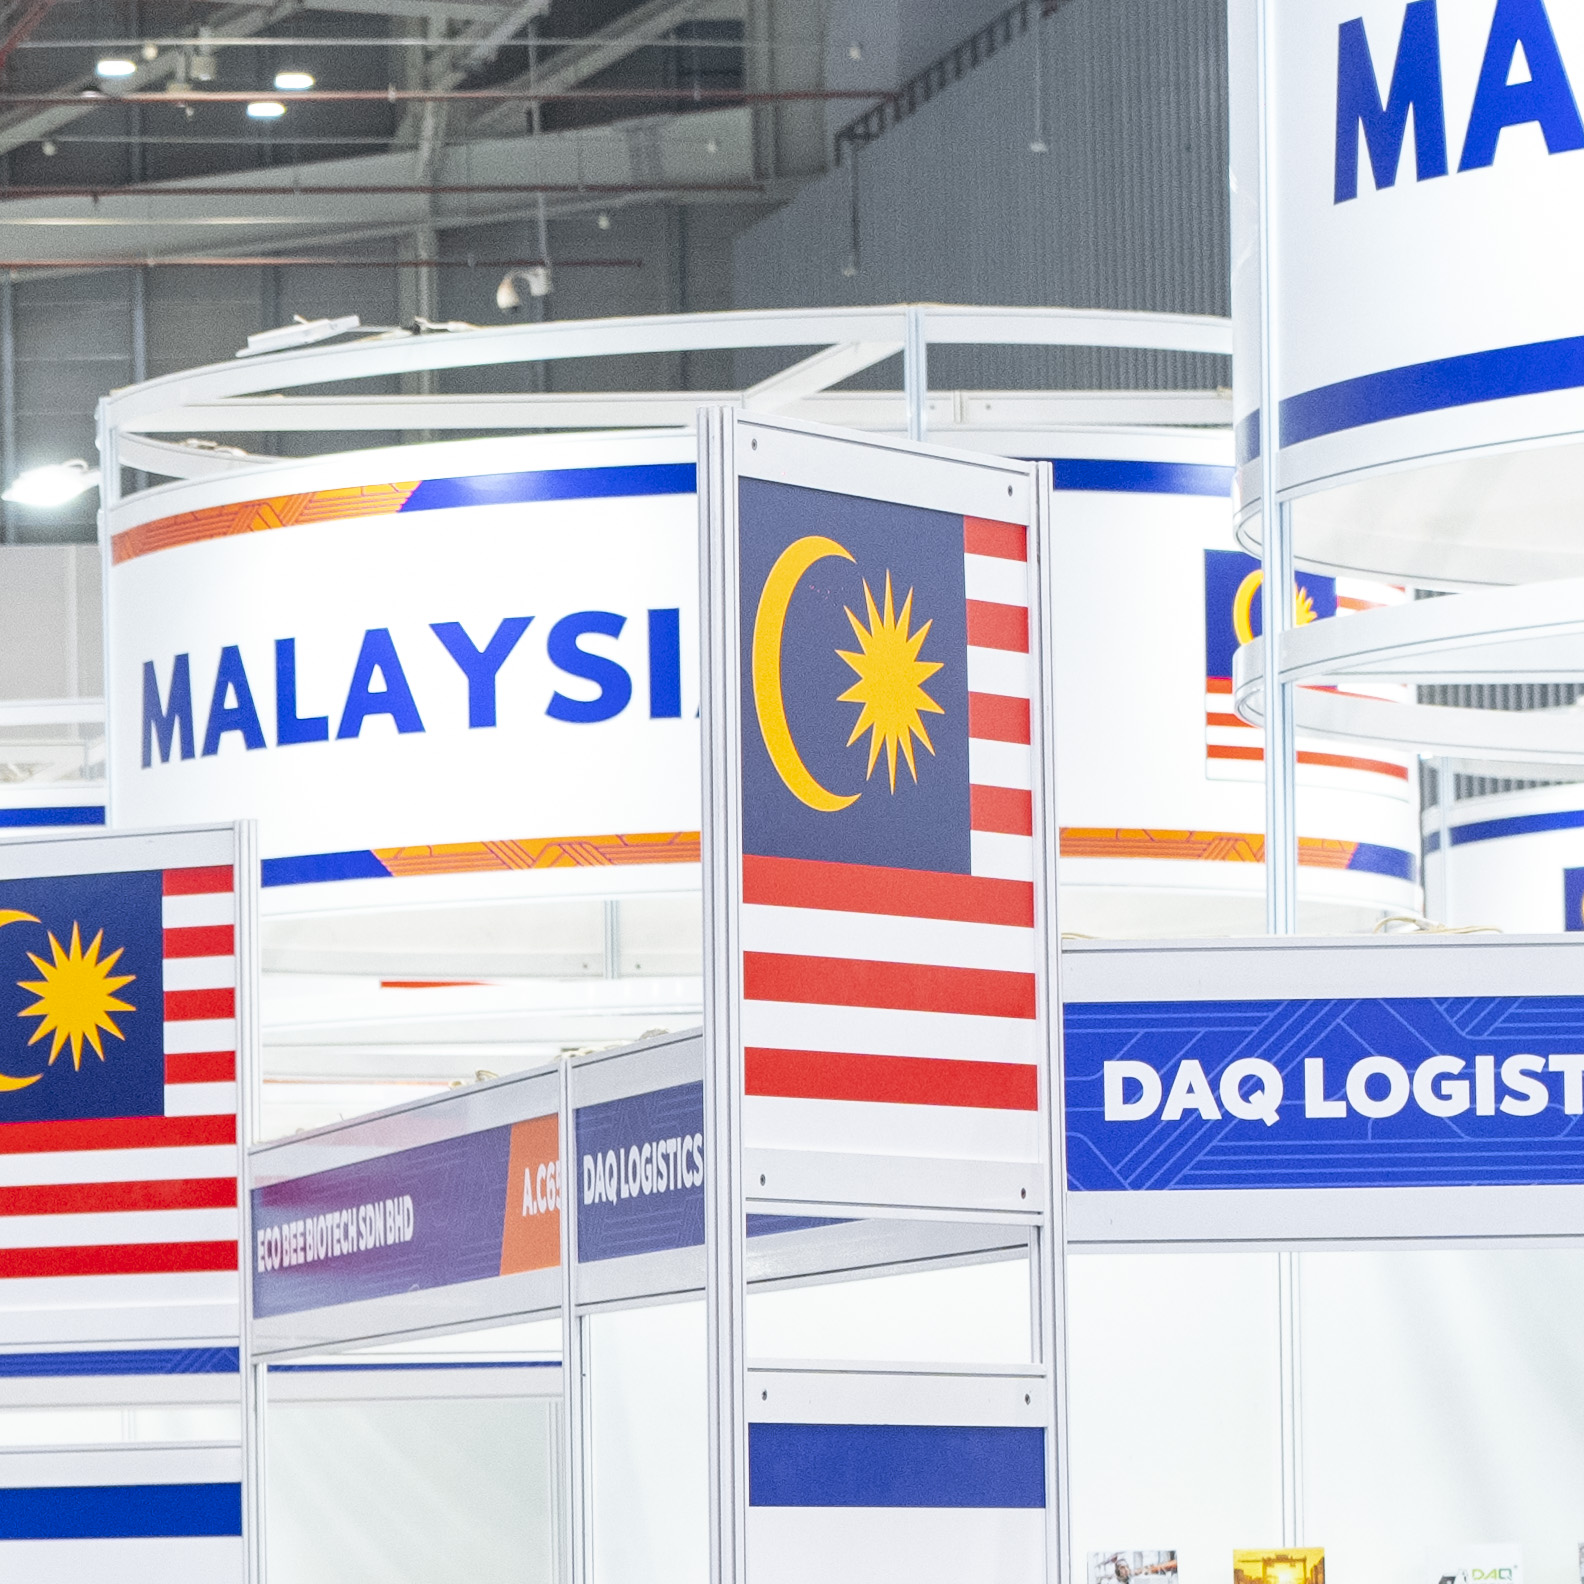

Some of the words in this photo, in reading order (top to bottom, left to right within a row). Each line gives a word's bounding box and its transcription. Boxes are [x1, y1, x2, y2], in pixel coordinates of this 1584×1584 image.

[141, 607, 700, 770] MALAYSI
[1103, 1056, 1284, 1127] DAQ
[1304, 1053, 1584, 1119] LOGIST
[583, 1149, 618, 1206] DAQ
[619, 1132, 704, 1199] LOGISTICS
[257, 1225, 281, 1273] ECO
[282, 1219, 305, 1268] BEE
[306, 1207, 358, 1263] BIOTECH
[358, 1201, 385, 1252] SDN
[385, 1194, 414, 1246] BHD
[1472, 1568, 1513, 1581] DAQ
